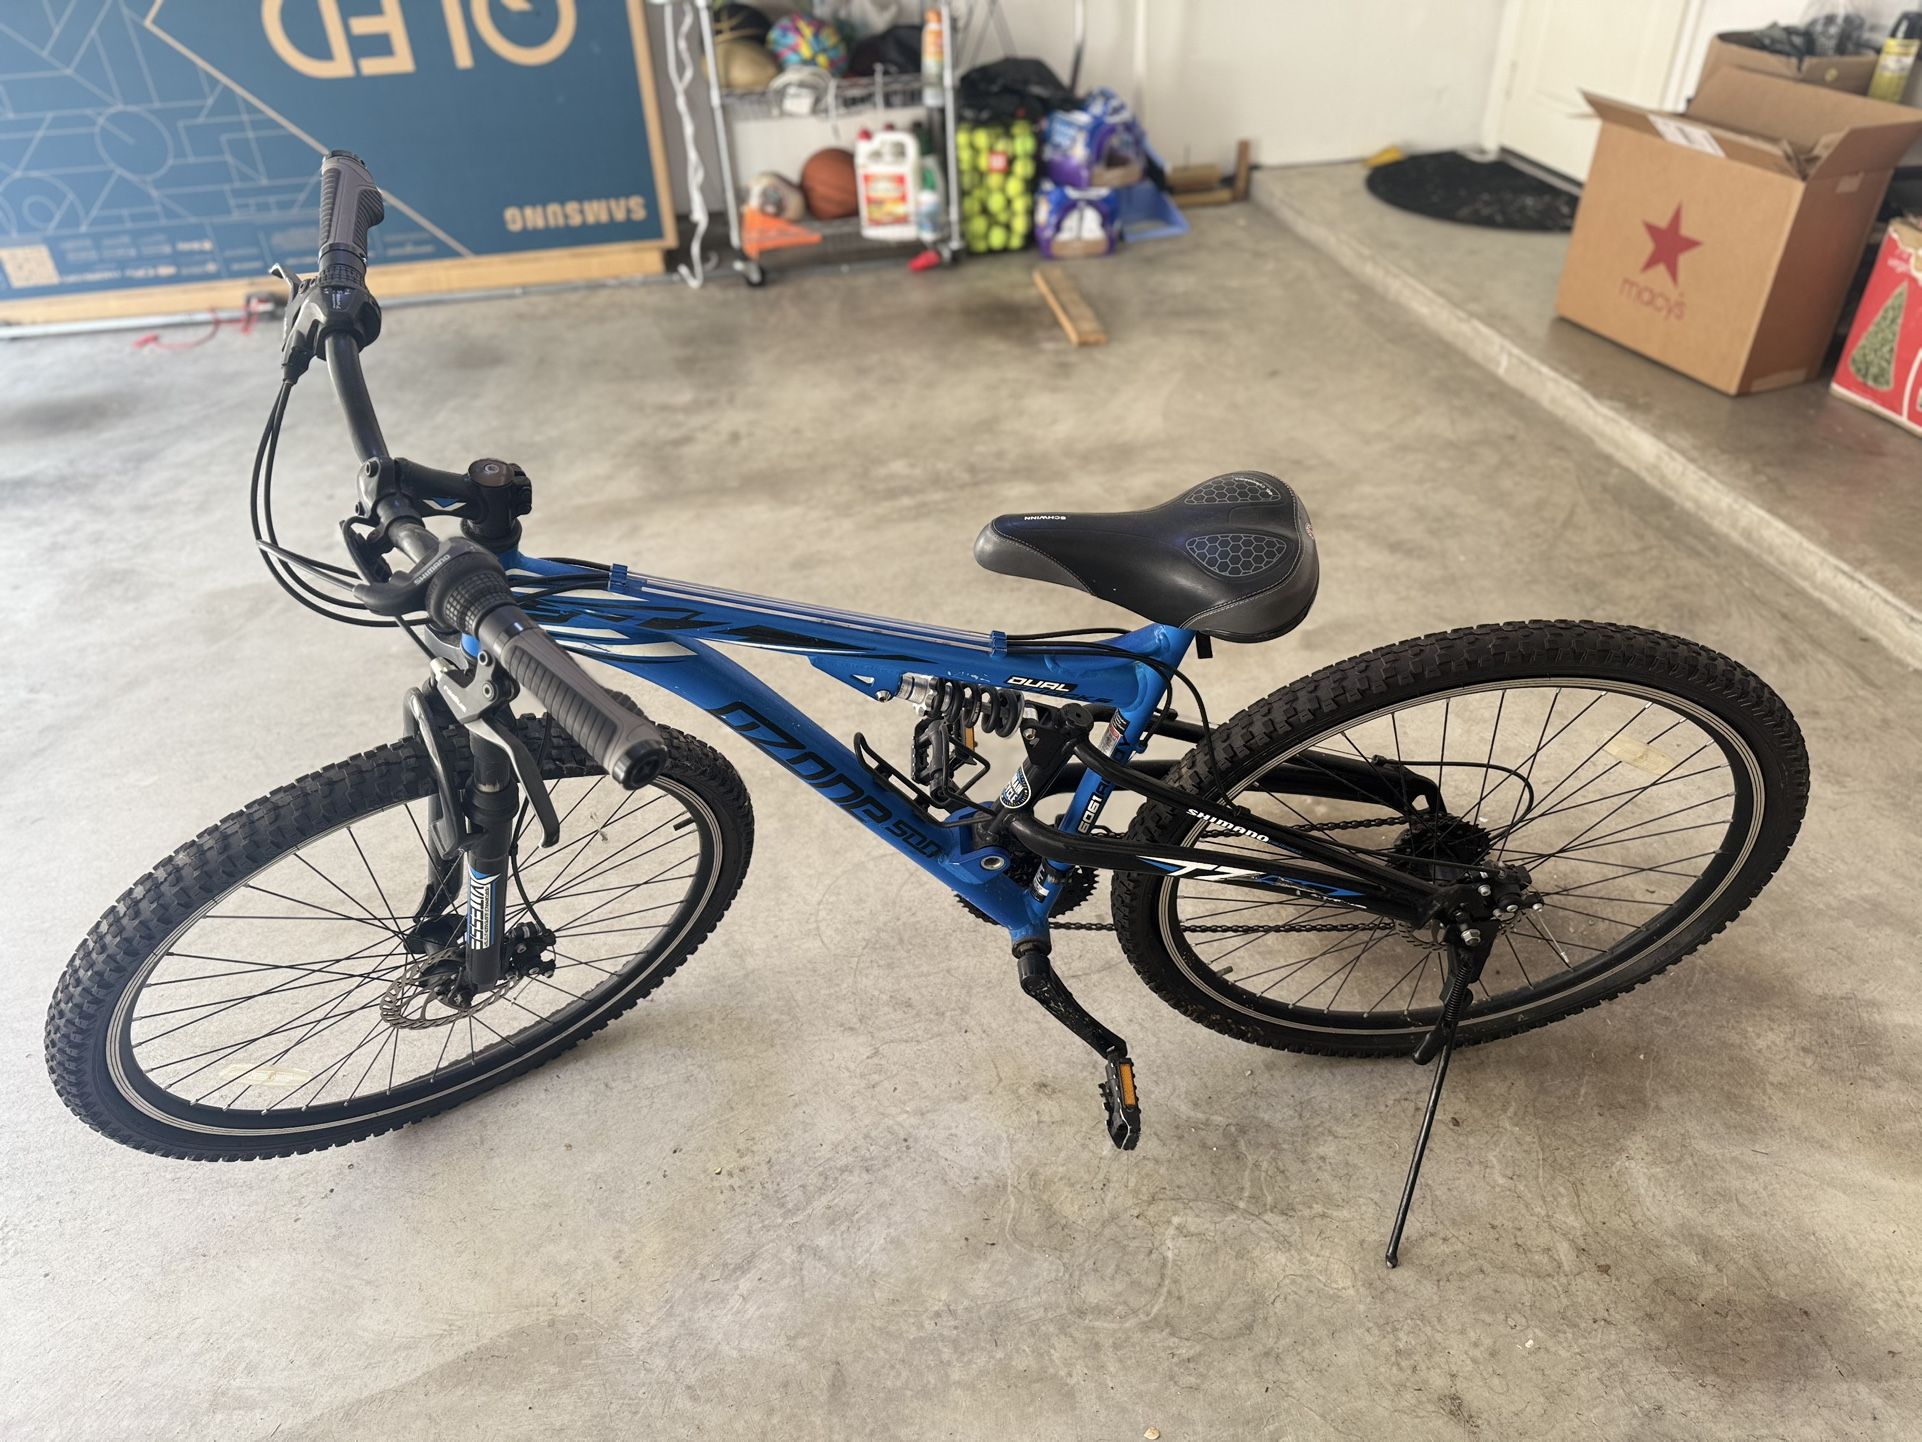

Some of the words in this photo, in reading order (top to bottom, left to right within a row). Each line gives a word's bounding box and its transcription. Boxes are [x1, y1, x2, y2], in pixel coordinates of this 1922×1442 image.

[503, 195, 647, 232] SAMSUNG
[1619, 278, 1687, 322] macy's
[413, 553, 451, 586] SHIMANO
[1007, 676, 1070, 692] DUAL
[1077, 794, 1103, 835] 6061
[1185, 807, 1270, 843] SHIMANO
[884, 818, 943, 859] 500
[470, 885, 484, 949] VITESSE
